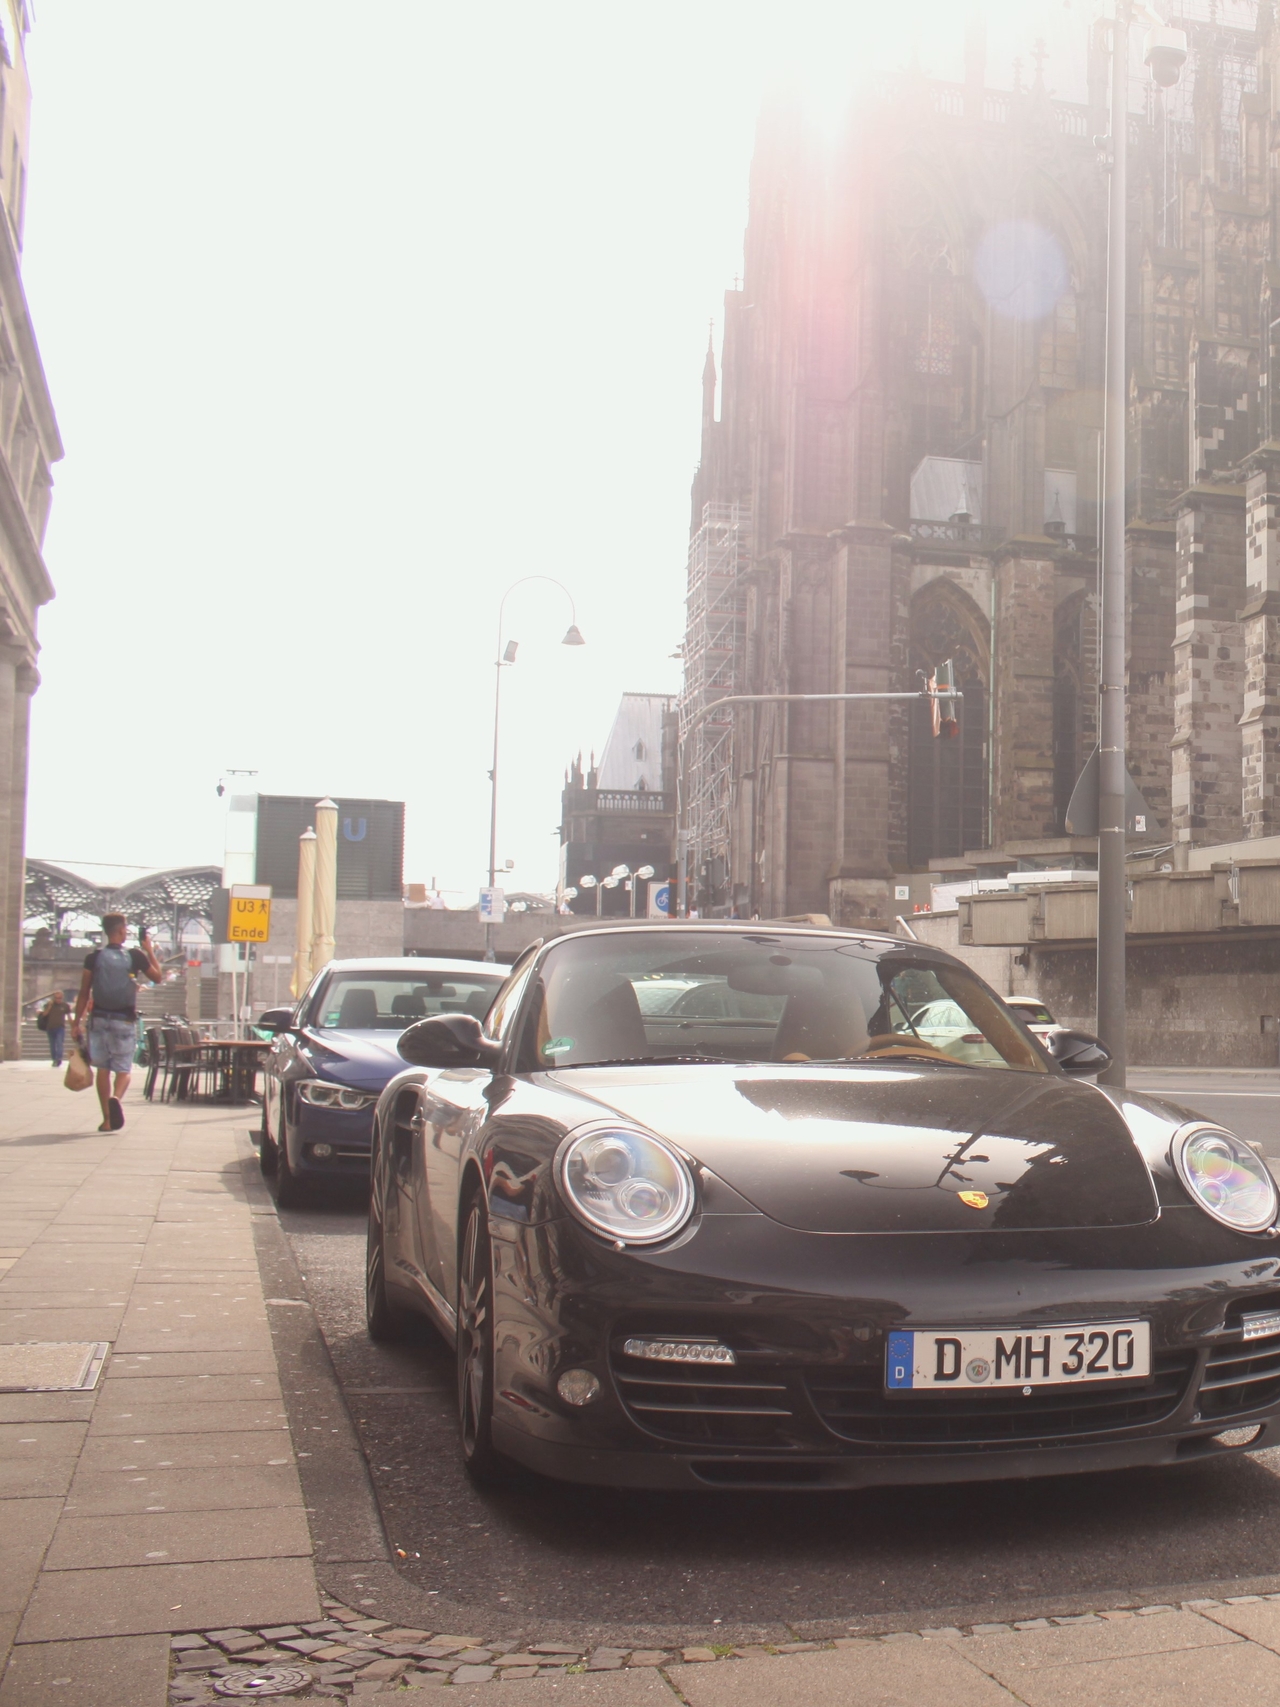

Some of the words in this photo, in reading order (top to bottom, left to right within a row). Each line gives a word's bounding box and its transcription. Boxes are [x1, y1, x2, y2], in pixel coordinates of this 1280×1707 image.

[343, 817, 367, 842] U
[236, 900, 255, 913] U3
[232, 926, 264, 938] Ende
[934, 1337, 962, 1381] D
[995, 1333, 1051, 1380] MH
[1061, 1327, 1134, 1375] 320
[895, 1366, 905, 1379] D
